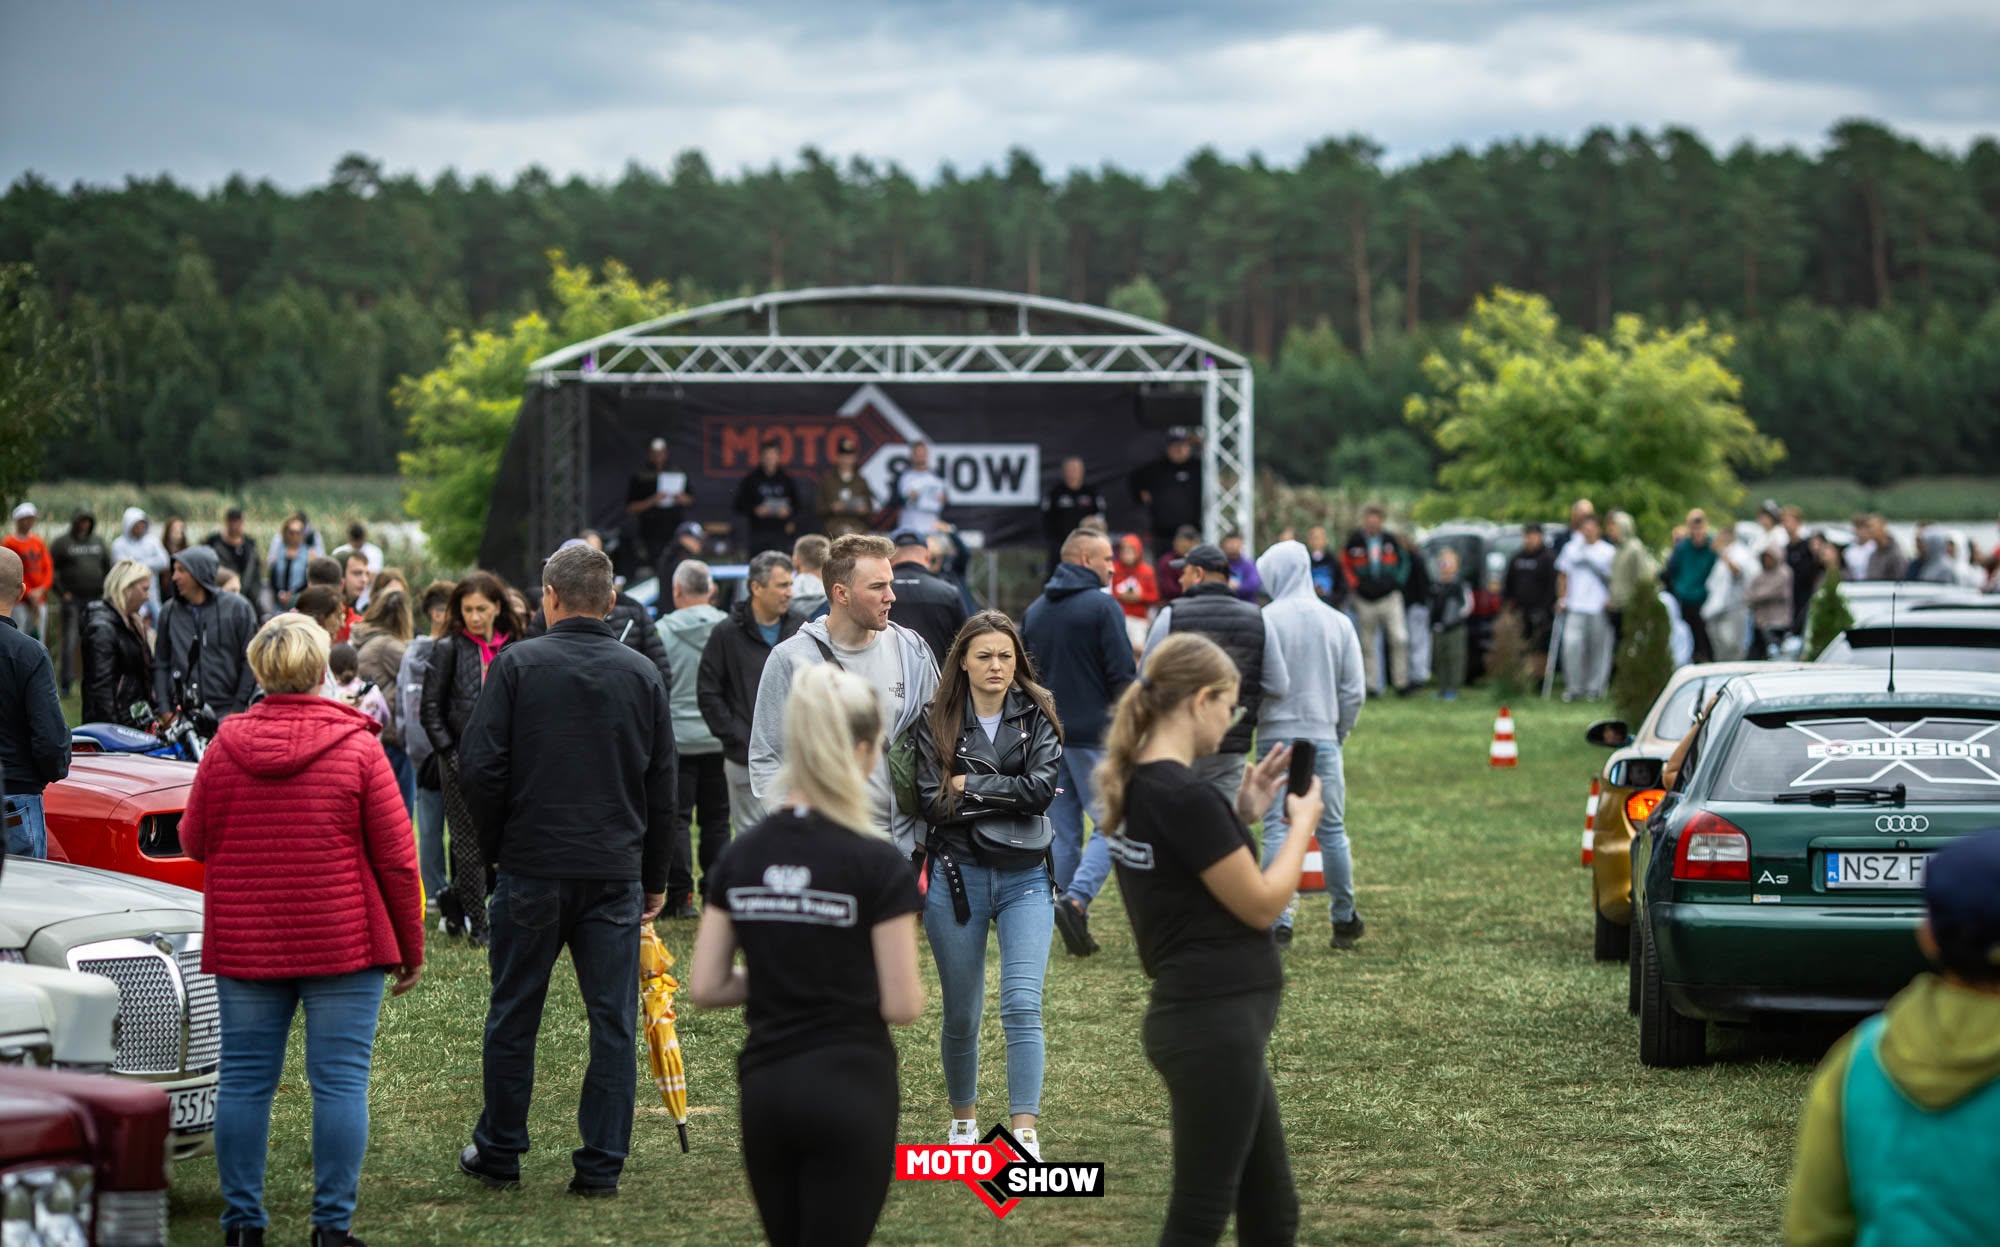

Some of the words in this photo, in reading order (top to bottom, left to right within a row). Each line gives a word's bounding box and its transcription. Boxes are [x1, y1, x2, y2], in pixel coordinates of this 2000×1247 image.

[720, 425, 860, 468] MOTO
[1758, 870, 1789, 884] A3
[1844, 856, 1899, 881] NSZ
[1909, 856, 1930, 881] F
